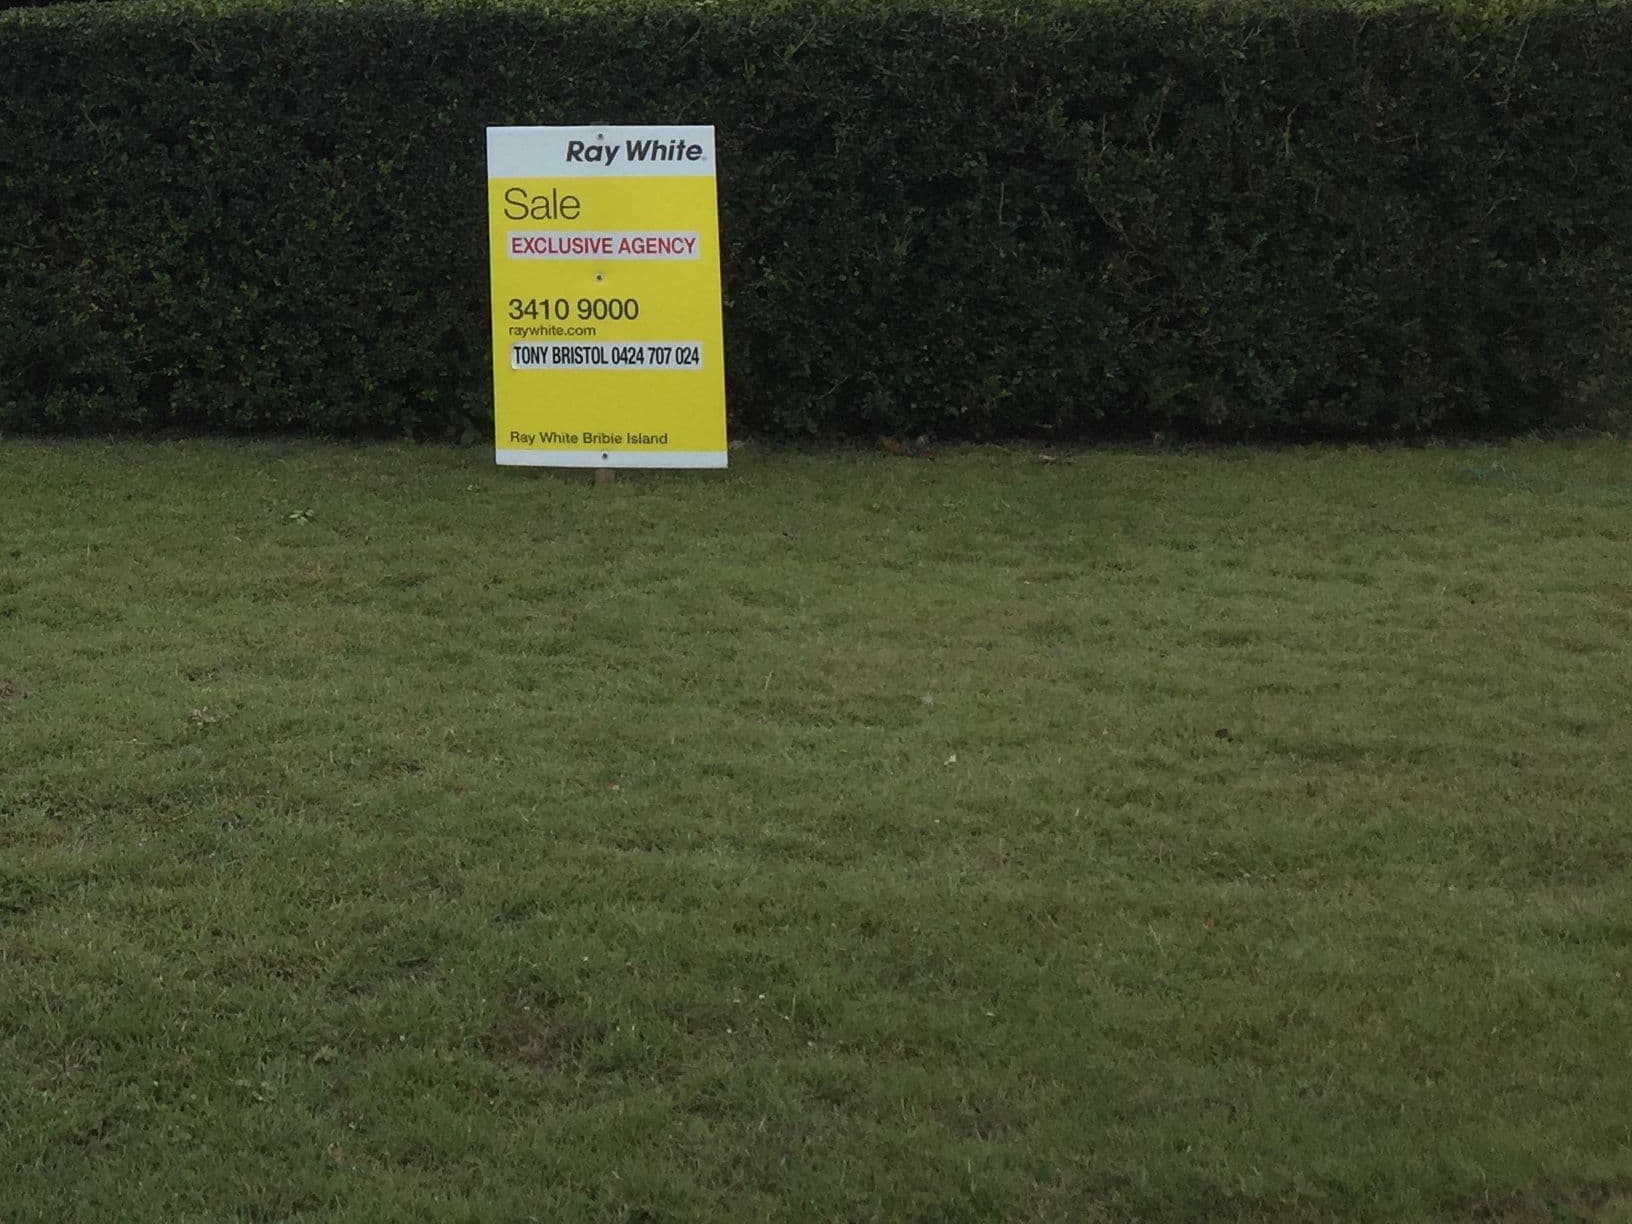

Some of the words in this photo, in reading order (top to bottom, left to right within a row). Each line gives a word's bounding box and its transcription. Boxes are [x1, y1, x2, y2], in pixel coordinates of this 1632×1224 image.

[566, 140, 620, 166] Ray
[626, 139, 703, 161] White
[504, 187, 581, 220] Sale
[511, 237, 613, 254] EXCLUSIVE
[618, 237, 696, 254] AGENCY
[508, 298, 569, 320] 3410
[577, 298, 639, 320] 9000
[508, 325, 596, 338] raywhite.com
[513, 346, 548, 364] TONY
[552, 346, 608, 364] BRISTOL
[611, 346, 644, 364] 0424
[648, 346, 672, 364] 707
[675, 346, 700, 364] 024
[510, 431, 536, 445] Ray
[539, 432, 578, 444] White
[583, 432, 622, 444] Bribie
[627, 432, 668, 445] Island
